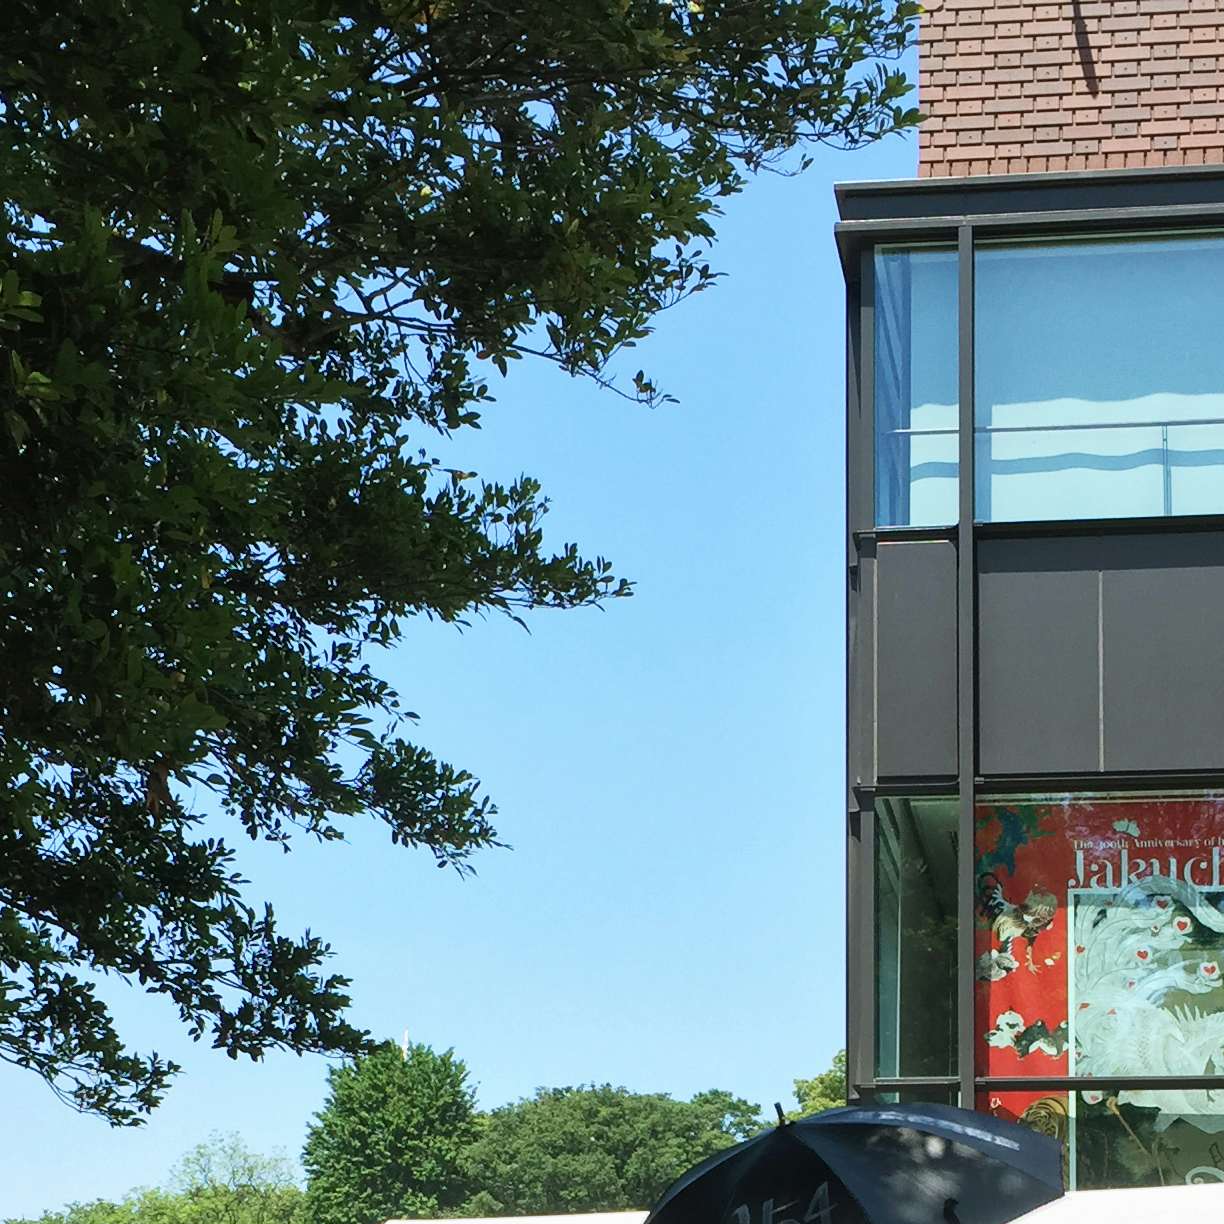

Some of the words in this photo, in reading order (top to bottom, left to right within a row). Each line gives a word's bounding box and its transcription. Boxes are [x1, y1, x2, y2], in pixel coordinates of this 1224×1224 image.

[1073, 839, 1094, 849] The
[1134, 837, 1200, 848] Anniversary
[1203, 836, 1216, 846] of
